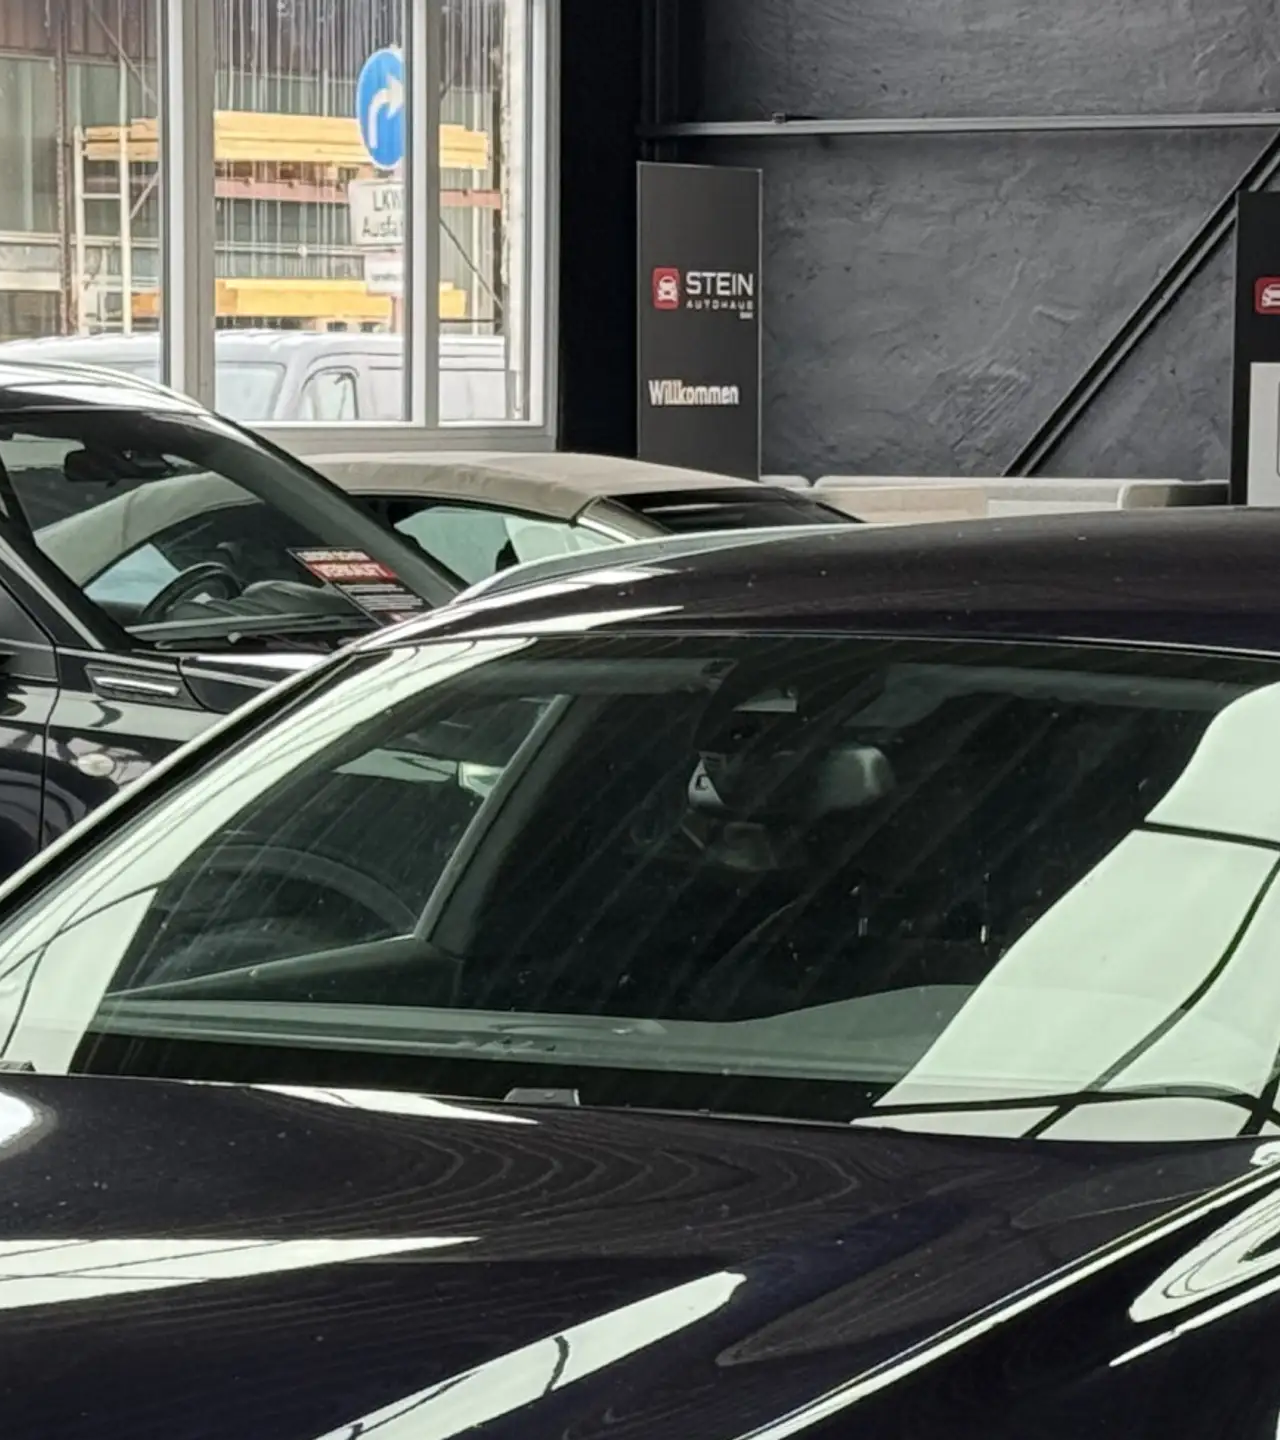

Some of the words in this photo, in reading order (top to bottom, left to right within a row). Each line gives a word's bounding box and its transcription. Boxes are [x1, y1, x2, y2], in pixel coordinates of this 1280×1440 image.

[685, 271, 754, 296] STEIN
[685, 299, 754, 310] AUTOHAUS
[648, 379, 740, 406] Willkommen
